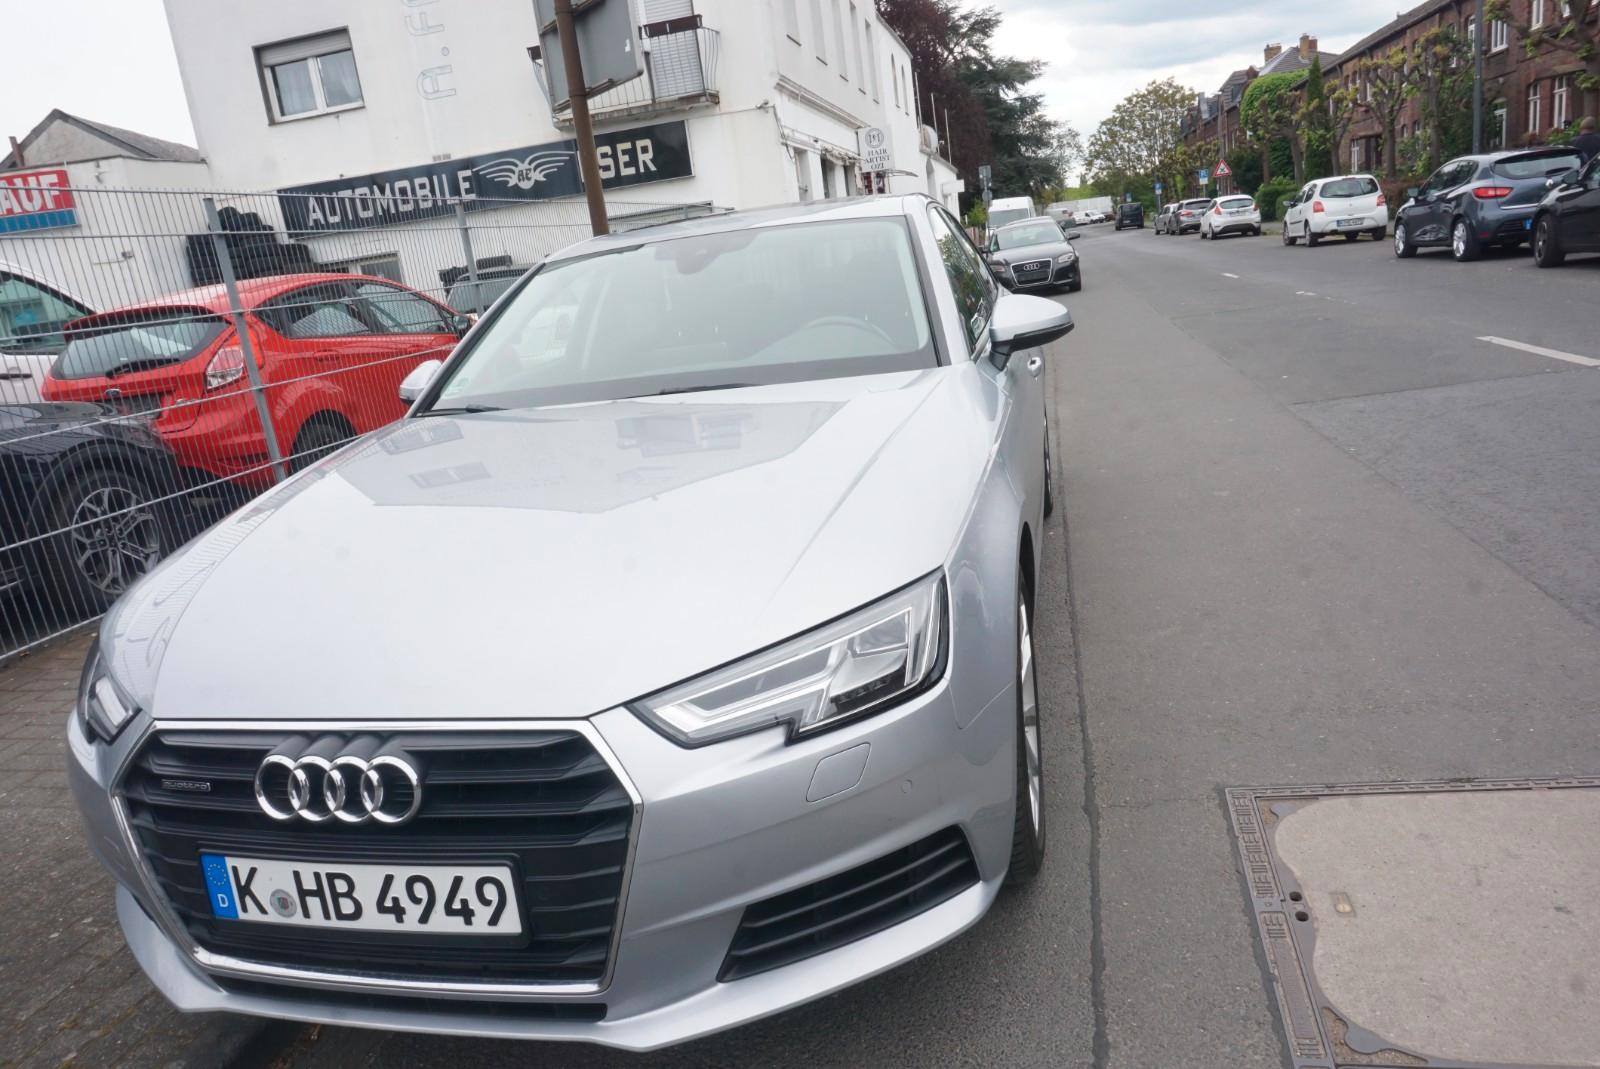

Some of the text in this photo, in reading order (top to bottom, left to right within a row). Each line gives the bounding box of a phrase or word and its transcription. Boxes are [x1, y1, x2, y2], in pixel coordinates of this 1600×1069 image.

[865, 155, 890, 164] ARTIST
[867, 148, 888, 157] HAIR
[308, 169, 477, 226] AUTOMOBILE
[218, 865, 507, 926] D K HB 4949
